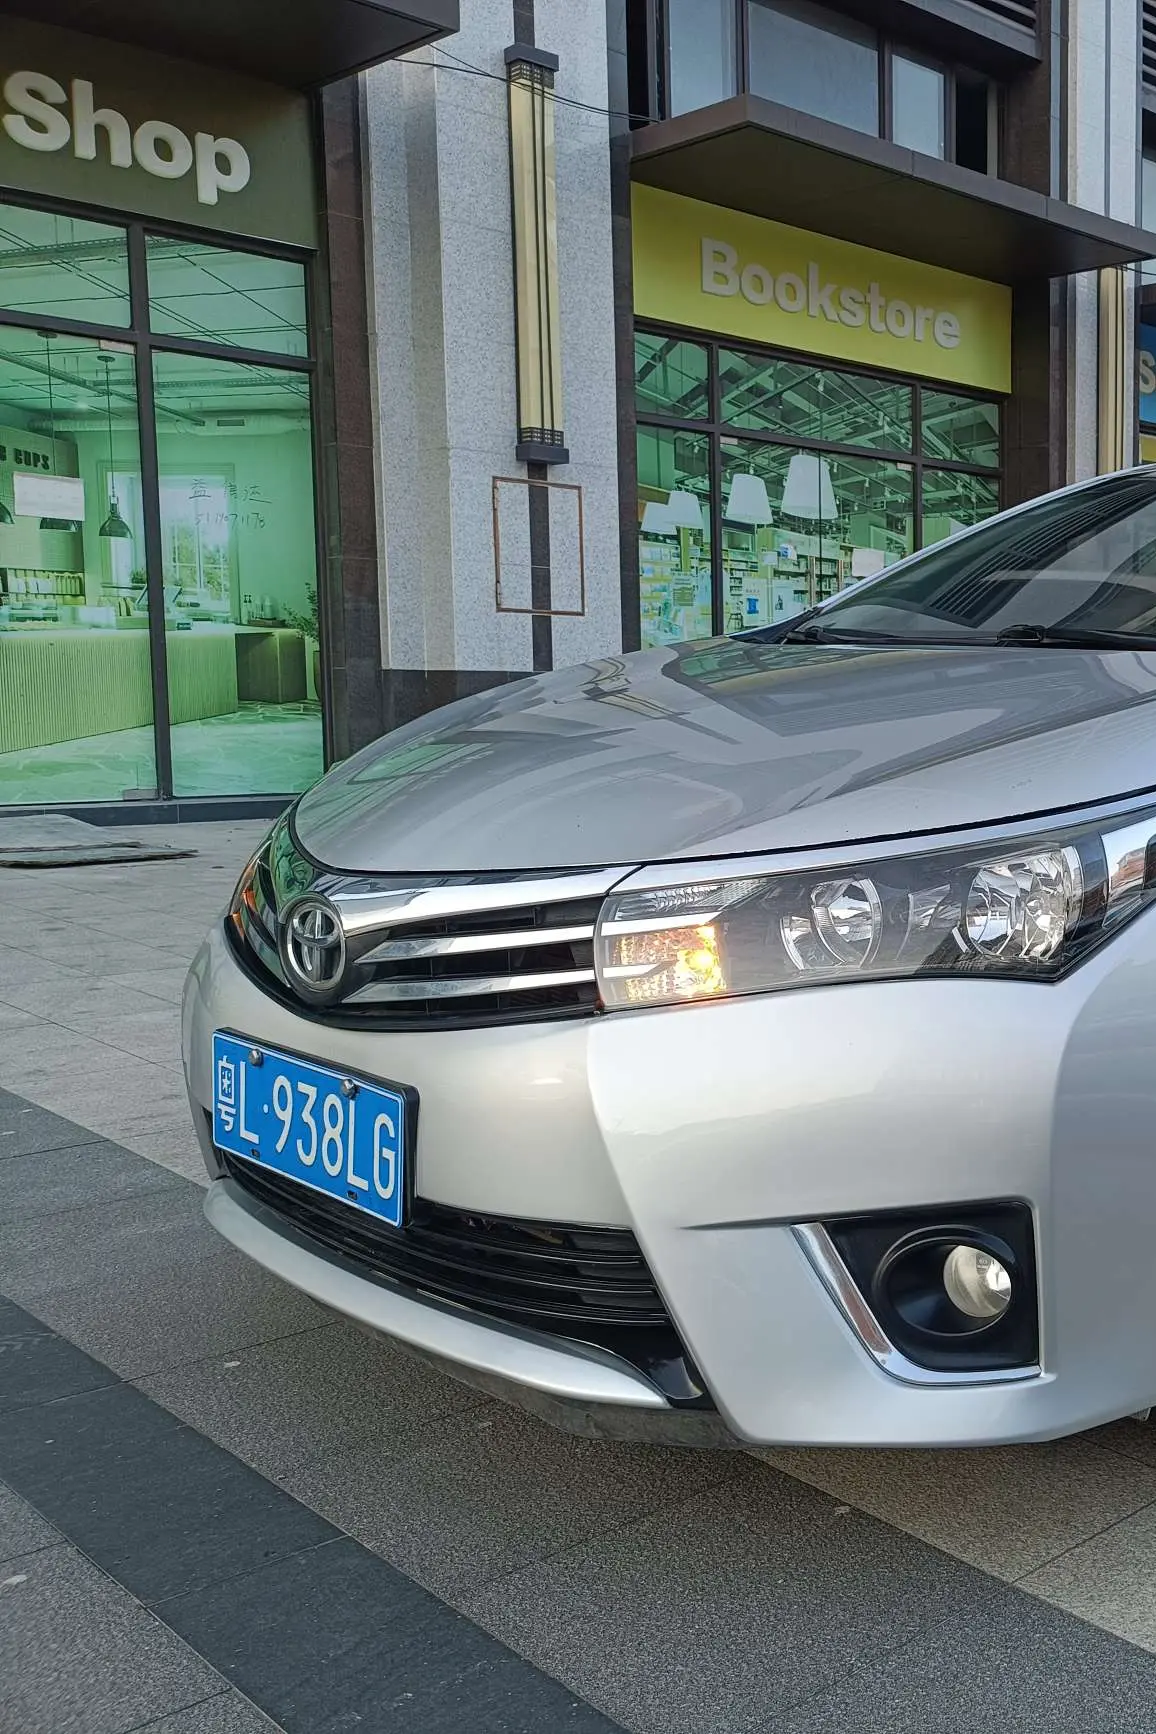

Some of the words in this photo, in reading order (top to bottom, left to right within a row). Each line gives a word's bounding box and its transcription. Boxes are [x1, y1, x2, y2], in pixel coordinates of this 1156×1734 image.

[2, 70, 251, 206] Shop
[699, 236, 962, 350] Bookstore
[14, 448, 50, 470] CUPS
